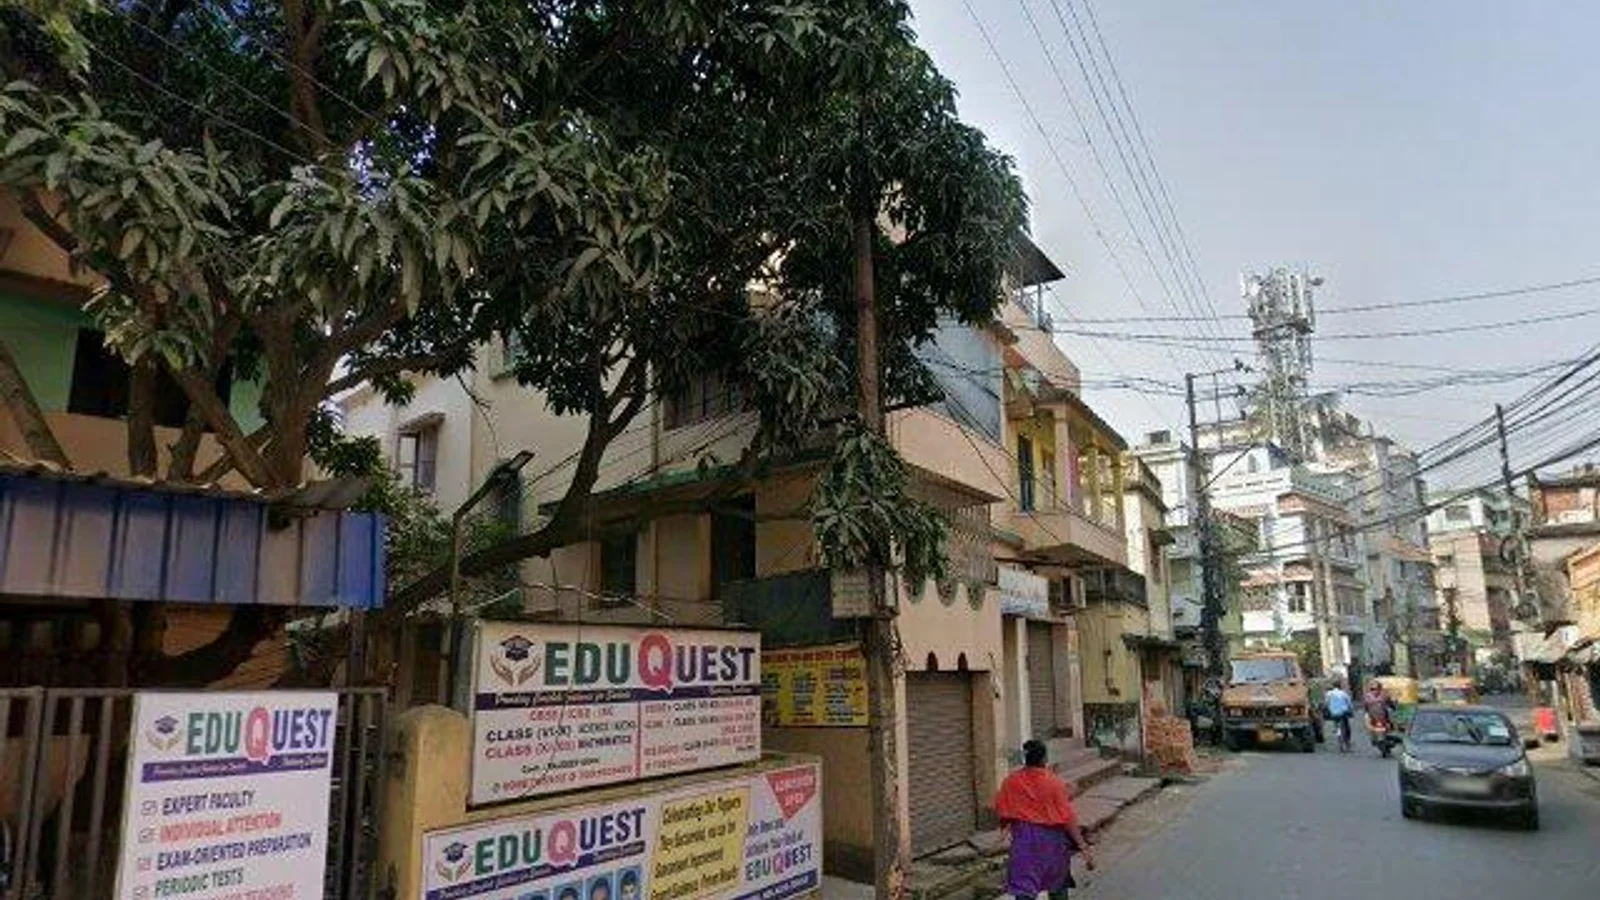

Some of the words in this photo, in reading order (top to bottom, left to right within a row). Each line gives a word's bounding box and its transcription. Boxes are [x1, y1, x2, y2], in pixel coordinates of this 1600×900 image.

[544, 633, 756, 691] EDUQUEST
[187, 707, 332, 765] EDUQUEST
[485, 745, 532, 760] CLASS
[486, 728, 533, 743] CLASS
[162, 794, 208, 816] EXPERT
[156, 841, 246, 871] EXAM-ORIENTED
[247, 831, 312, 857] PREPARATION
[475, 808, 646, 876] EDUQUEST
[154, 873, 209, 898] PERIODIC
[211, 867, 244, 886] TESTS
